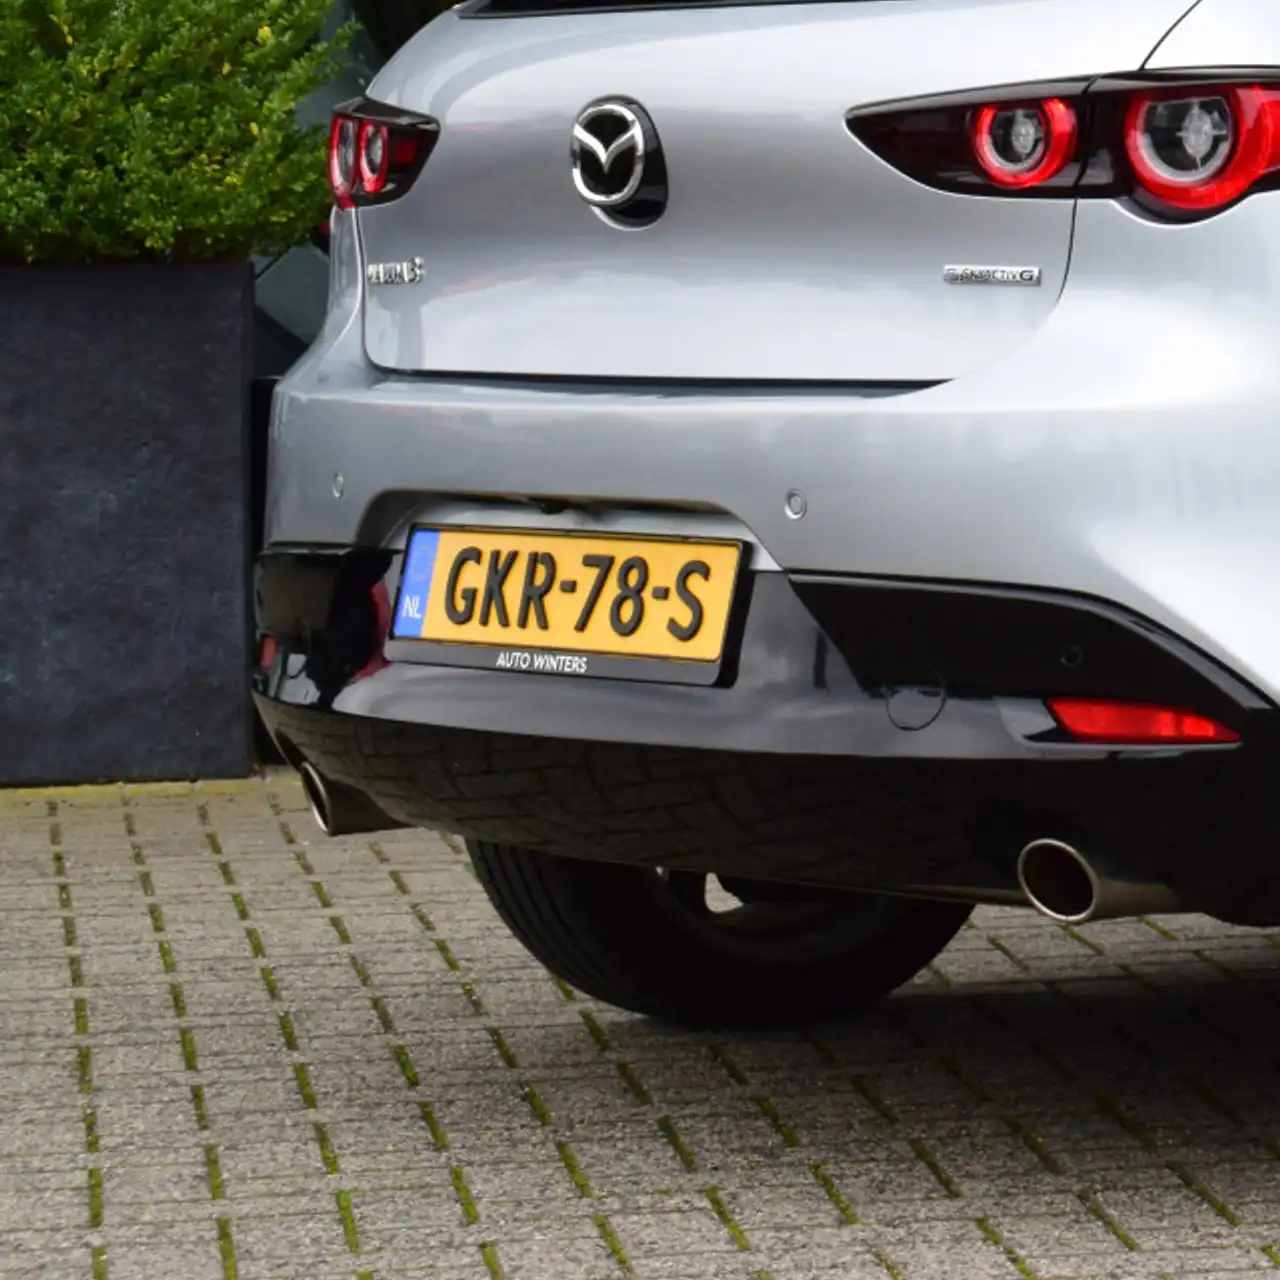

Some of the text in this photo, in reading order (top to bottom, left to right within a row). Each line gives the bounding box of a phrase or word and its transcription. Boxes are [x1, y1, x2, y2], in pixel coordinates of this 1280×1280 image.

[444, 546, 711, 642] GKR-78-S
[402, 595, 421, 619] NL
[496, 651, 588, 674] AUTO WINTERS
